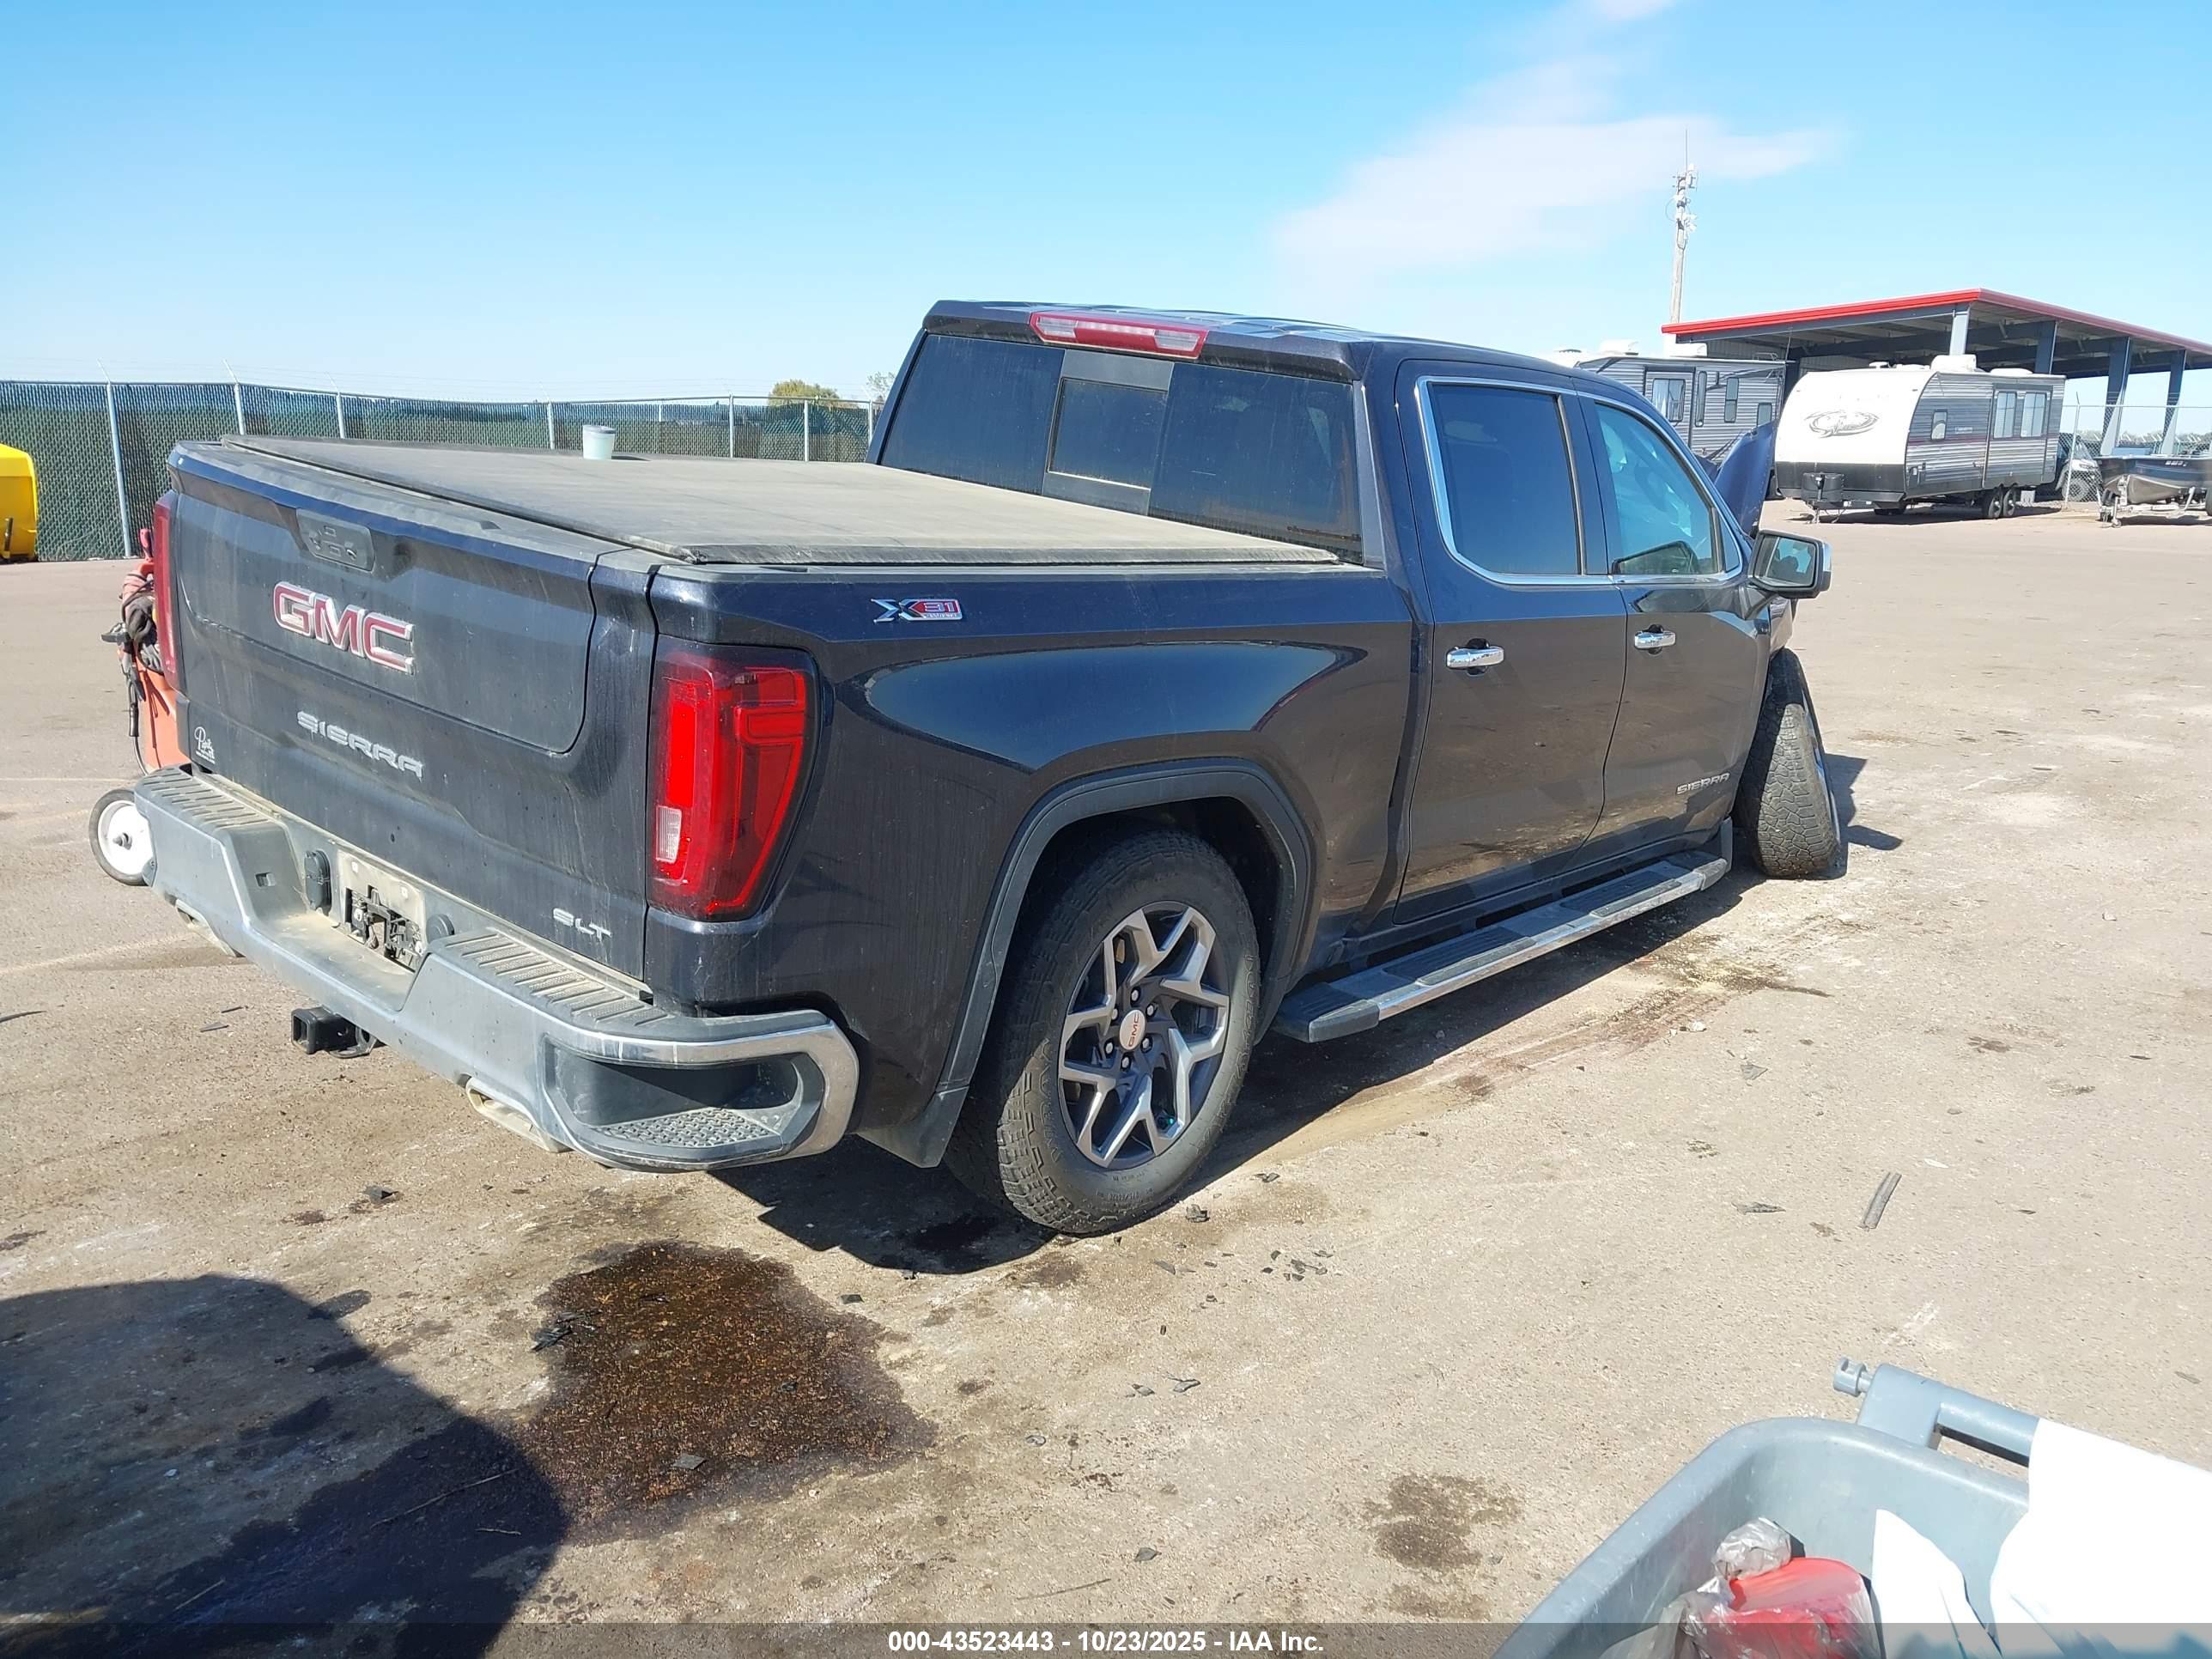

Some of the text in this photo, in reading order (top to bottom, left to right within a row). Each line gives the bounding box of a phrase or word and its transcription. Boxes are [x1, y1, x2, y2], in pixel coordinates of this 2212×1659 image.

[273, 580, 416, 676] GMC
[297, 711, 424, 781] SIERRA
[1676, 772, 1730, 796] SIERRA
[552, 907, 612, 943] SLT
[1128, 1012, 1139, 1048] GMC
